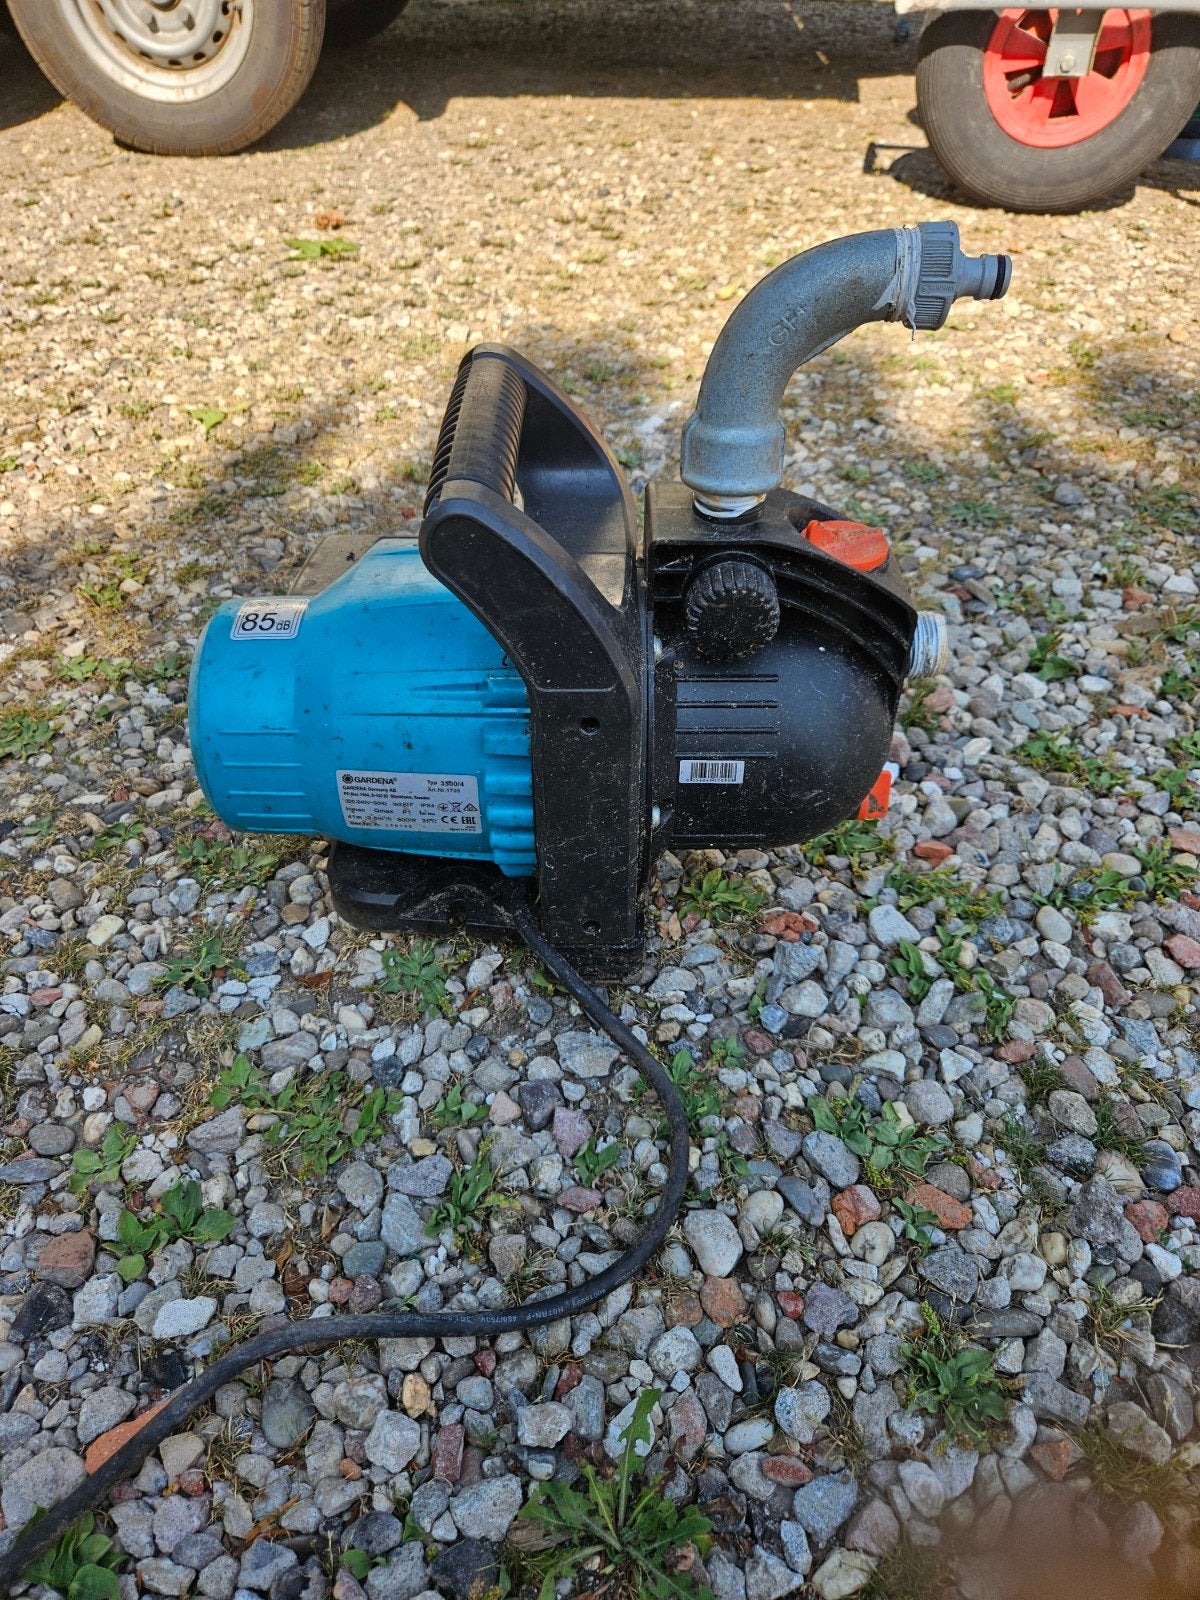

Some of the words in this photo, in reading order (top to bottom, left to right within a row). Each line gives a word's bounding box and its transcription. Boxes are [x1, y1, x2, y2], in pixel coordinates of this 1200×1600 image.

[241, 612, 277, 631] 85
[275, 620, 291, 631] dB
[354, 776, 395, 785] GARDENA
